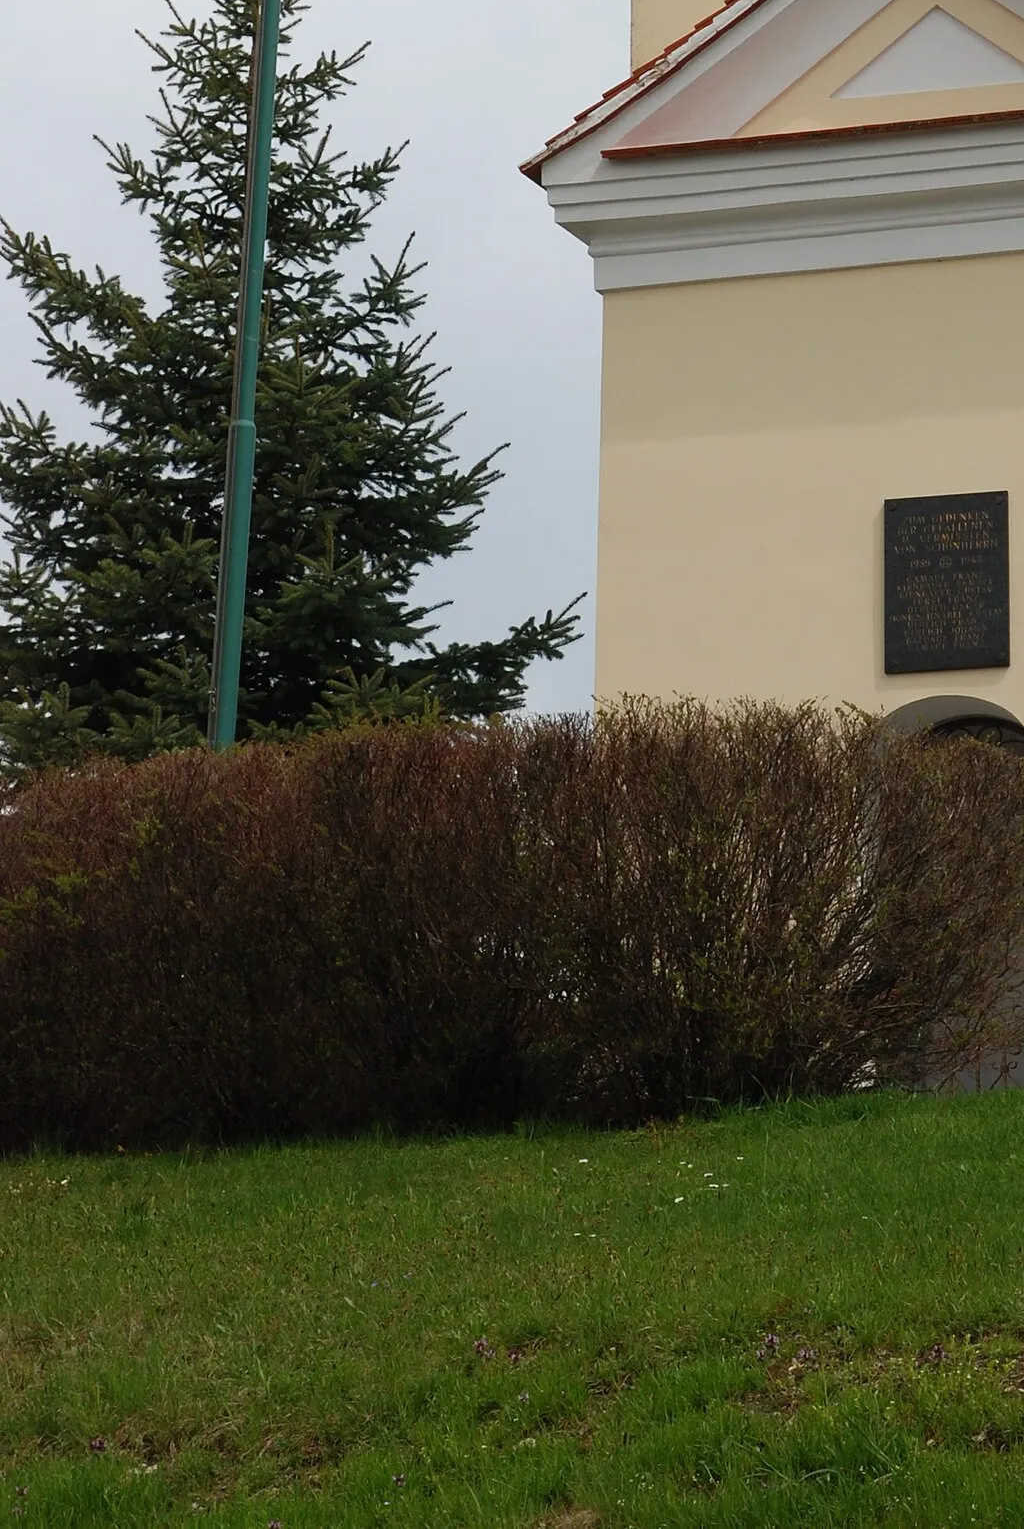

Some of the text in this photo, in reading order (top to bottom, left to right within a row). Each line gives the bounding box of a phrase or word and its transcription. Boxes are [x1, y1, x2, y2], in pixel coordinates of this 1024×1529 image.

[931, 510, 990, 523] GEDENKEN
[924, 521, 994, 532] GEFALLENEN
[920, 530, 990, 542] VERMISSTEN
[894, 545, 916, 554] VON
